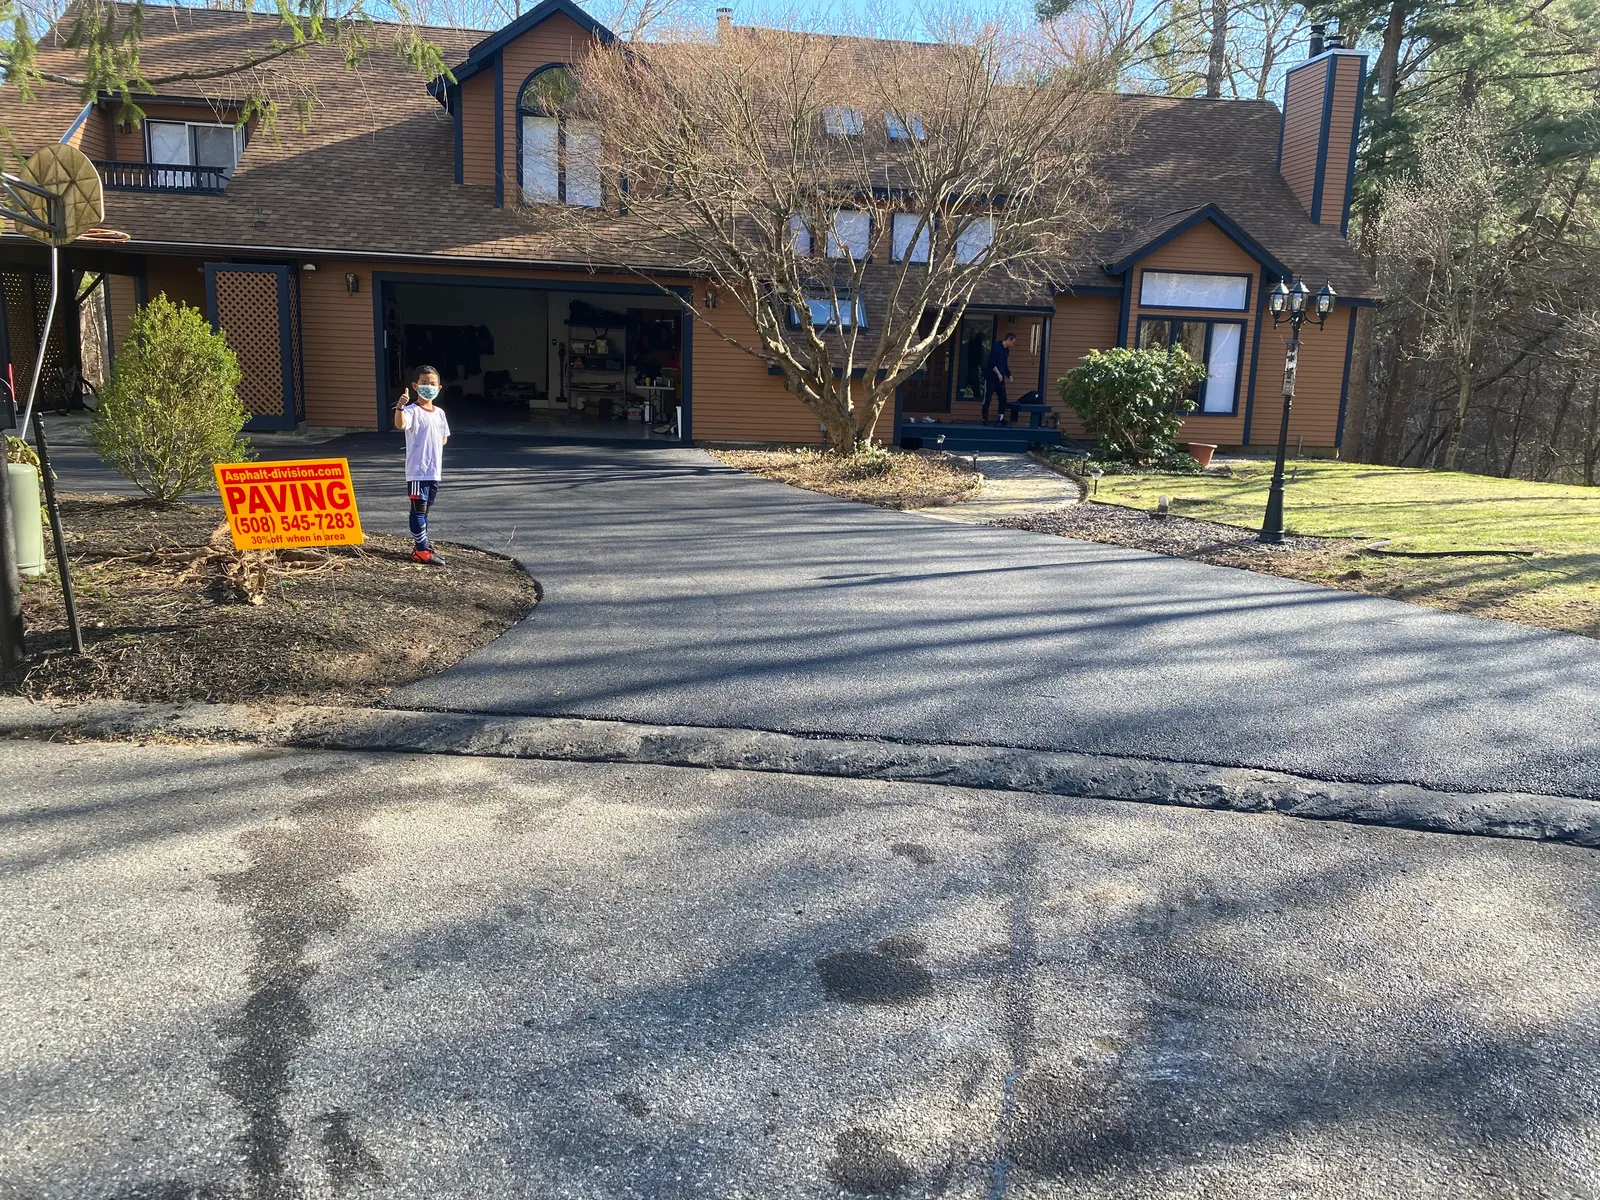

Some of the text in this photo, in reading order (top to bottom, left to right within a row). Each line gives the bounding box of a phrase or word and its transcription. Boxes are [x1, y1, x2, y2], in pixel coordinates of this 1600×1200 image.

[225, 467, 342, 482] Asphalt-division.com
[225, 481, 351, 514] PAVING
[235, 512, 355, 535] (508) 545-7283
[286, 533, 311, 543] when
[313, 533, 322, 542] in
[324, 533, 346, 541] area
